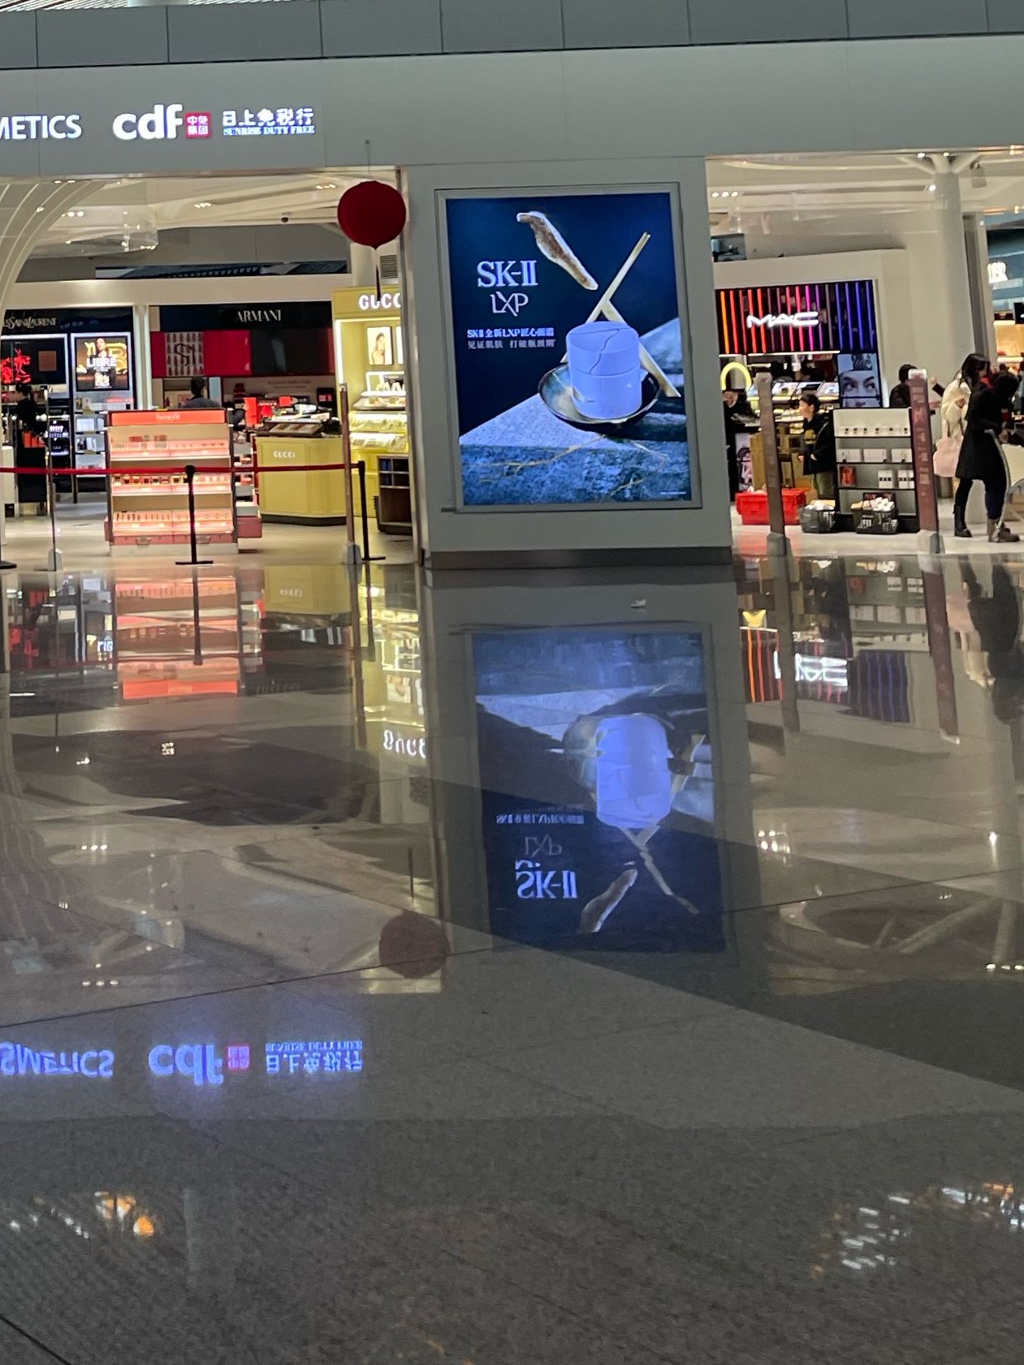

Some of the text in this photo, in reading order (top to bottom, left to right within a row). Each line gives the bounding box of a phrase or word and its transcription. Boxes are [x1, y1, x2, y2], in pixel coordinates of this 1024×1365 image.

[112, 103, 183, 140] cdf
[222, 107, 315, 126] 日上免税行
[263, 126, 289, 135] DUTY
[290, 125, 316, 135] FREE
[235, 309, 282, 323] ARMANI
[86, 356, 117, 367] LIBRE
[272, 450, 296, 458] GUCCI
